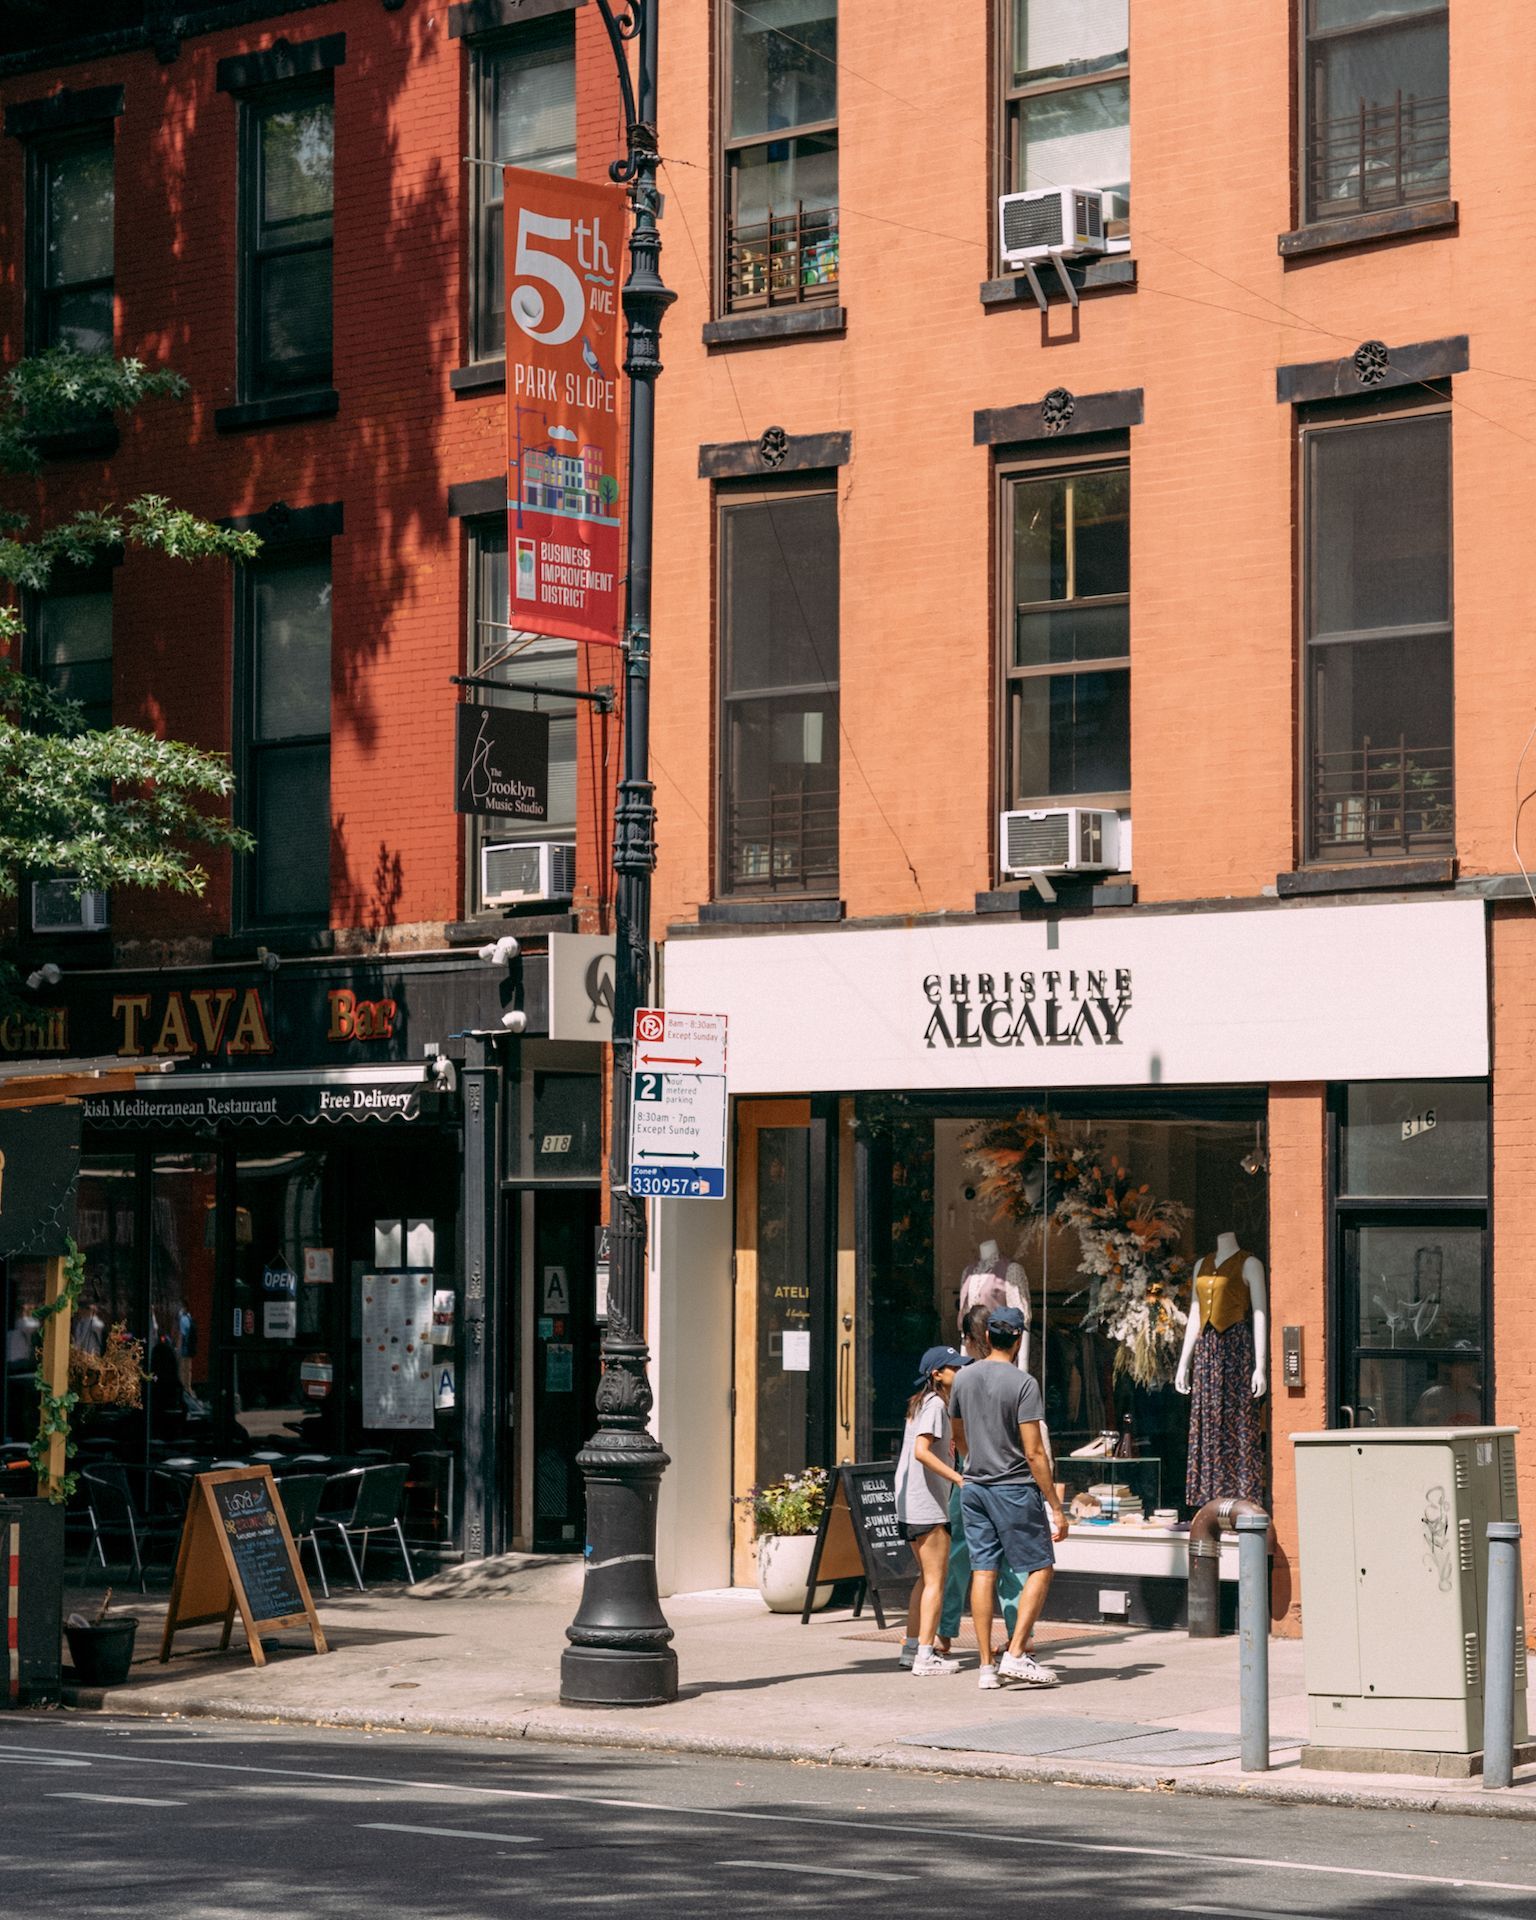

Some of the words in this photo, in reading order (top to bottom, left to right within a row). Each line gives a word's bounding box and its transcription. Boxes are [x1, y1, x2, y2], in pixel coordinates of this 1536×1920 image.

[511, 207, 614, 345] 5th
[590, 287, 616, 315] AVE.
[515, 363, 557, 402] PARK
[566, 373, 614, 413] SLOPE
[541, 542, 591, 568] BUSINESS
[541, 563, 613, 592] IMPROVEMENT
[541, 584, 585, 608] DISTRICT
[490, 768, 502, 778] The
[486, 797, 513, 811] Music
[515, 800, 544, 815] Studio
[923, 969, 1131, 1000] CHRISTINE
[112, 988, 272, 1055] TAVA
[328, 989, 396, 1041] Bar
[668, 1019, 683, 1027] 8am
[691, 1020, 717, 1029] 8:30am
[924, 998, 1128, 1043] ALCALAY
[668, 1031, 691, 1040] Except
[693, 1033, 718, 1041] Sunday
[641, 1074, 656, 1100] 2
[83, 1099, 110, 1117] kish
[113, 1098, 204, 1116] Mediterranean
[207, 1097, 277, 1114] Restaurant
[320, 1091, 350, 1109] Free
[353, 1088, 412, 1112] Delivery
[637, 1112, 669, 1122] 8:30am
[679, 1113, 695, 1123] 7pm
[637, 1124, 666, 1135] Except
[669, 1125, 700, 1136] Sunday
[1404, 1110, 1434, 1136] 316
[544, 1137, 568, 1151] 318
[633, 1178, 689, 1194] 330957
[264, 1272, 295, 1290] OPEN
[546, 1271, 564, 1298] A
[439, 1367, 455, 1395] A
[876, 1526, 899, 1537] SALE
